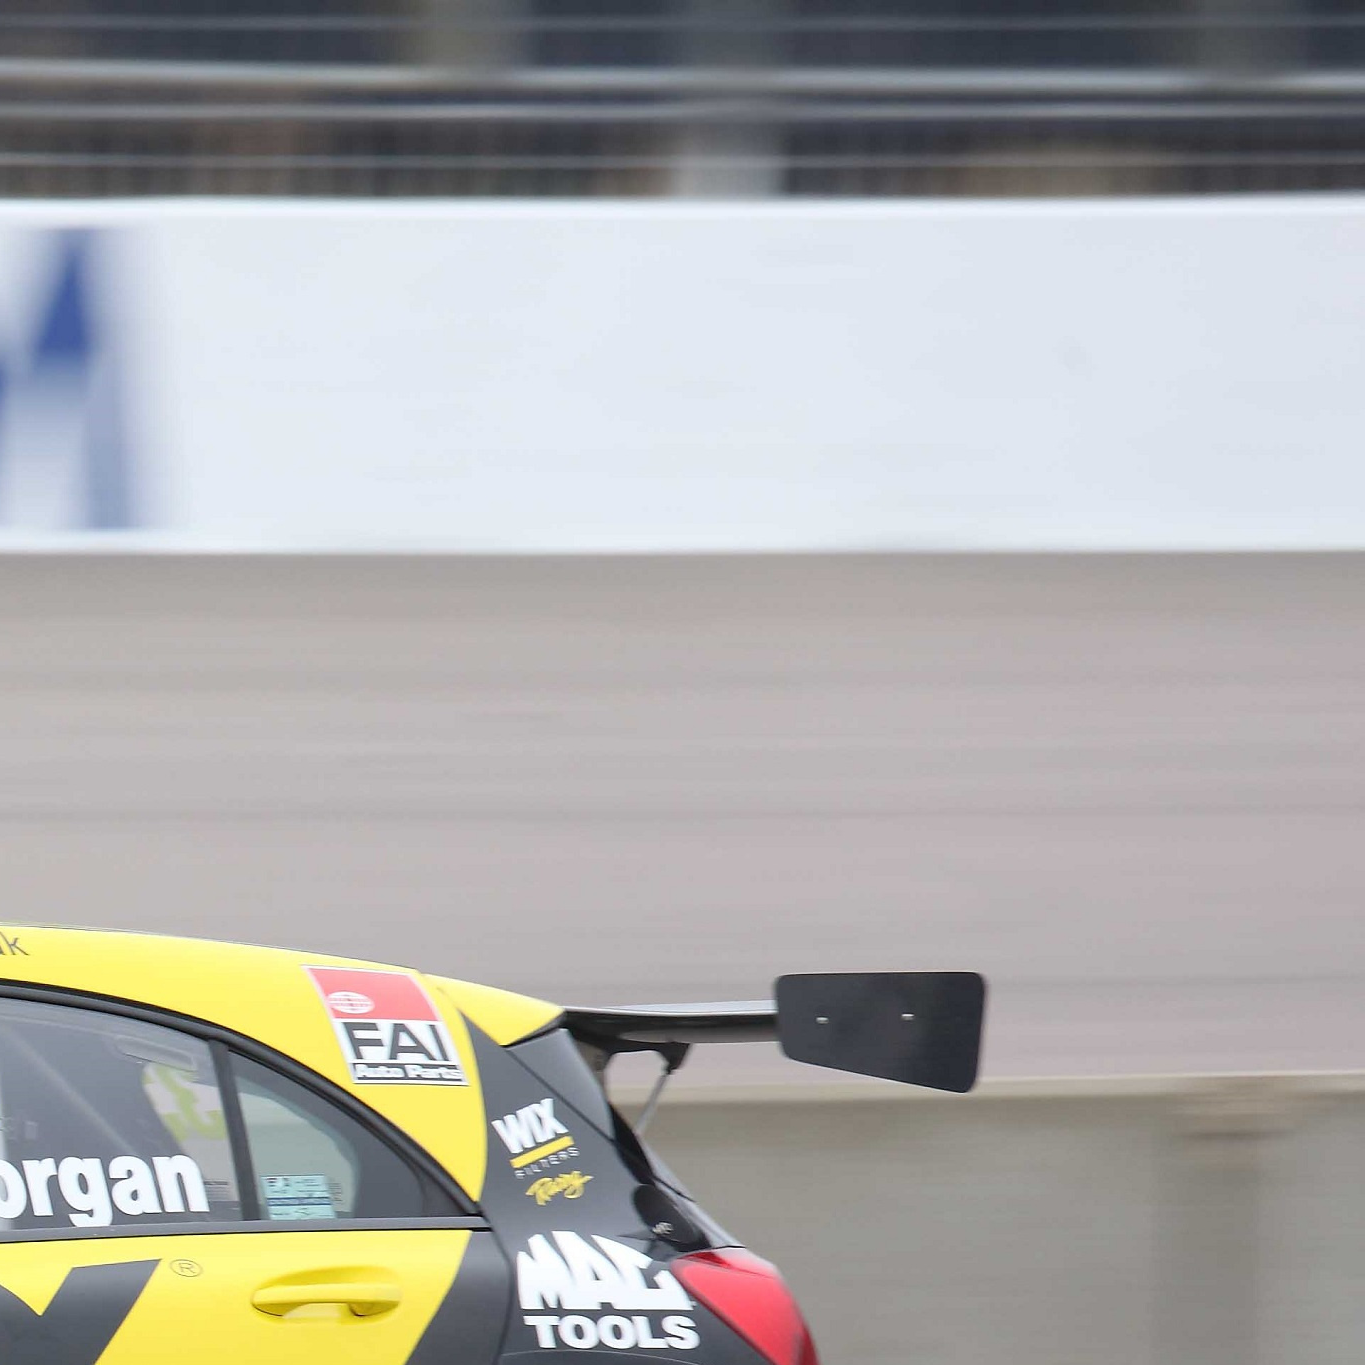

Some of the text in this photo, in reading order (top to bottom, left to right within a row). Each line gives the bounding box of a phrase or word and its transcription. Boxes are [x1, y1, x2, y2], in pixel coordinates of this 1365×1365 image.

[342, 1022, 450, 1061] FAI
[354, 1063, 464, 1080] Auto Parts
[491, 1098, 569, 1154] WIX
[516, 1230, 696, 1310] MAC
[522, 1315, 701, 1350] TOOLS
